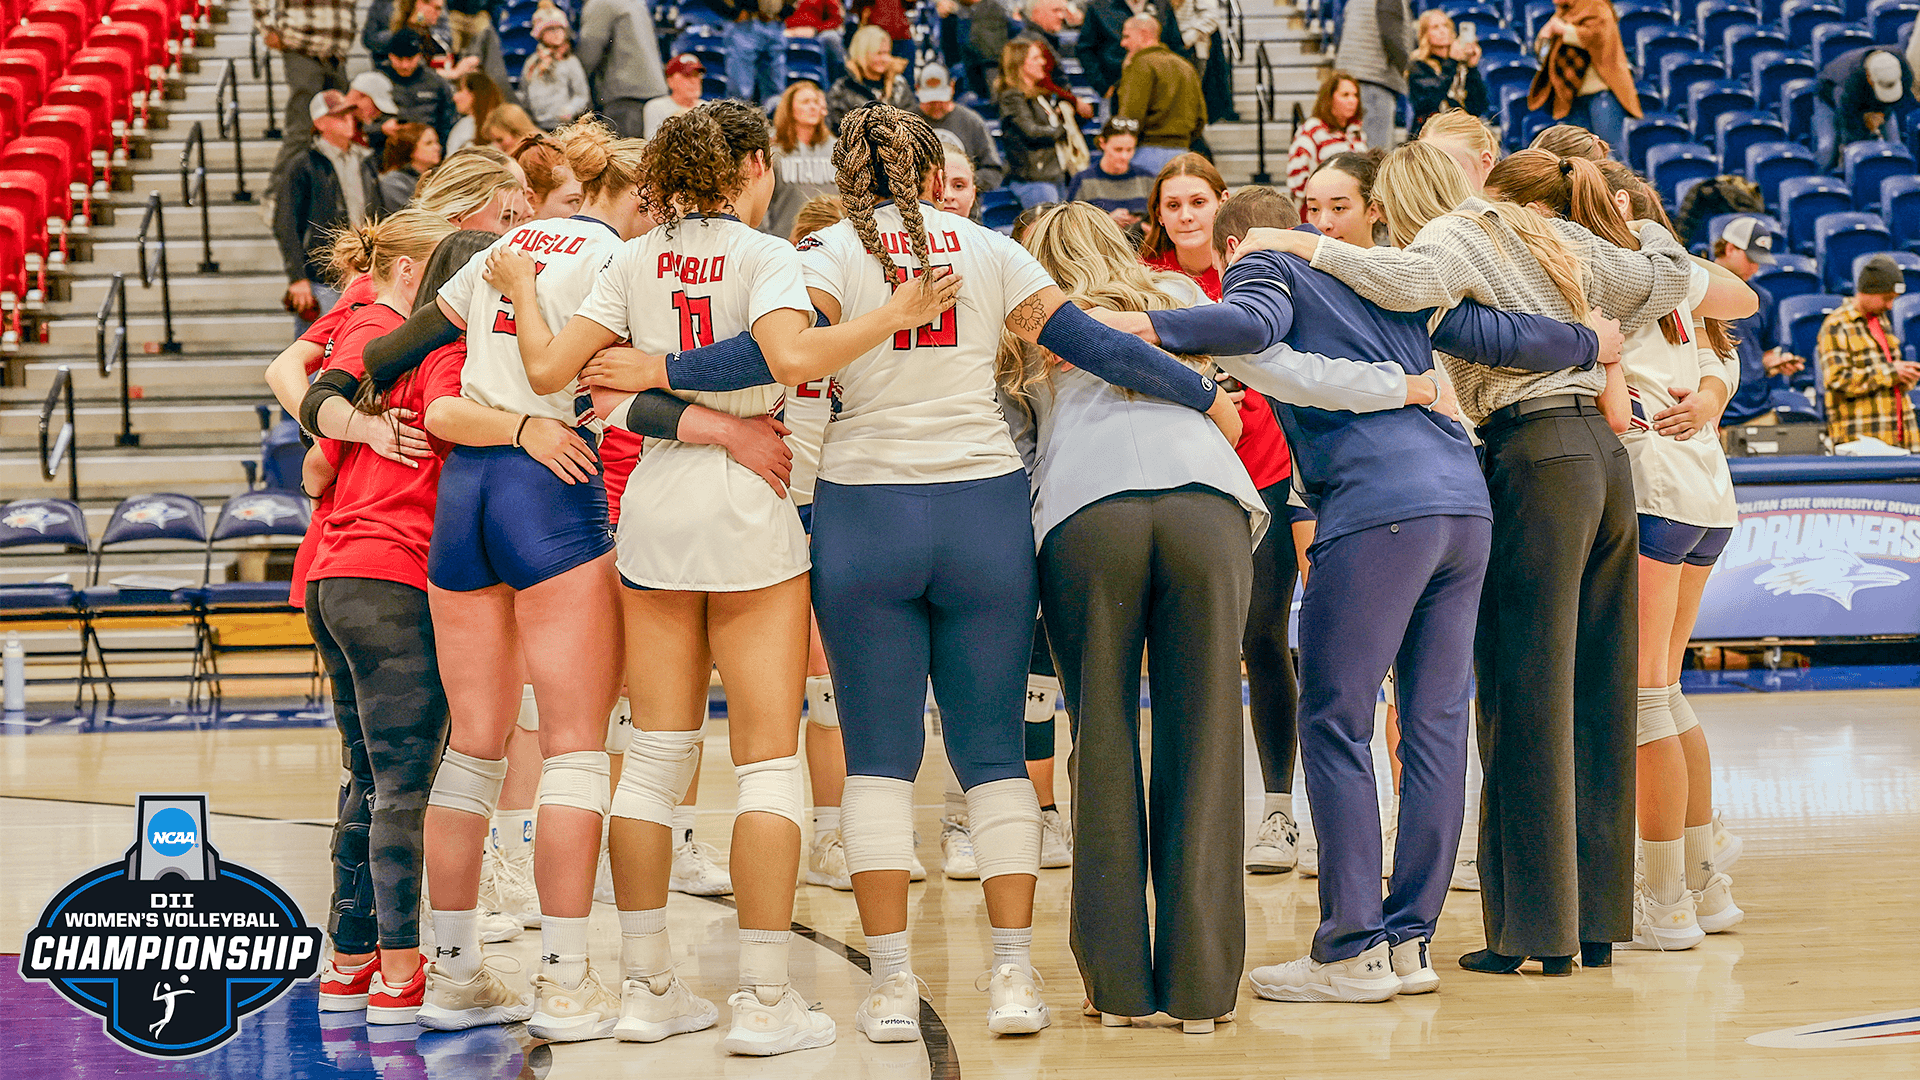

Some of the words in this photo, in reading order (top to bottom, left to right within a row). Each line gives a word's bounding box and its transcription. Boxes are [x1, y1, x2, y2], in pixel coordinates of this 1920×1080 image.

[866, 230, 962, 256] UELO
[1780, 497, 1811, 510] STATE
[1812, 496, 1873, 510] UNIVERSITY
[1873, 498, 1887, 511] OF
